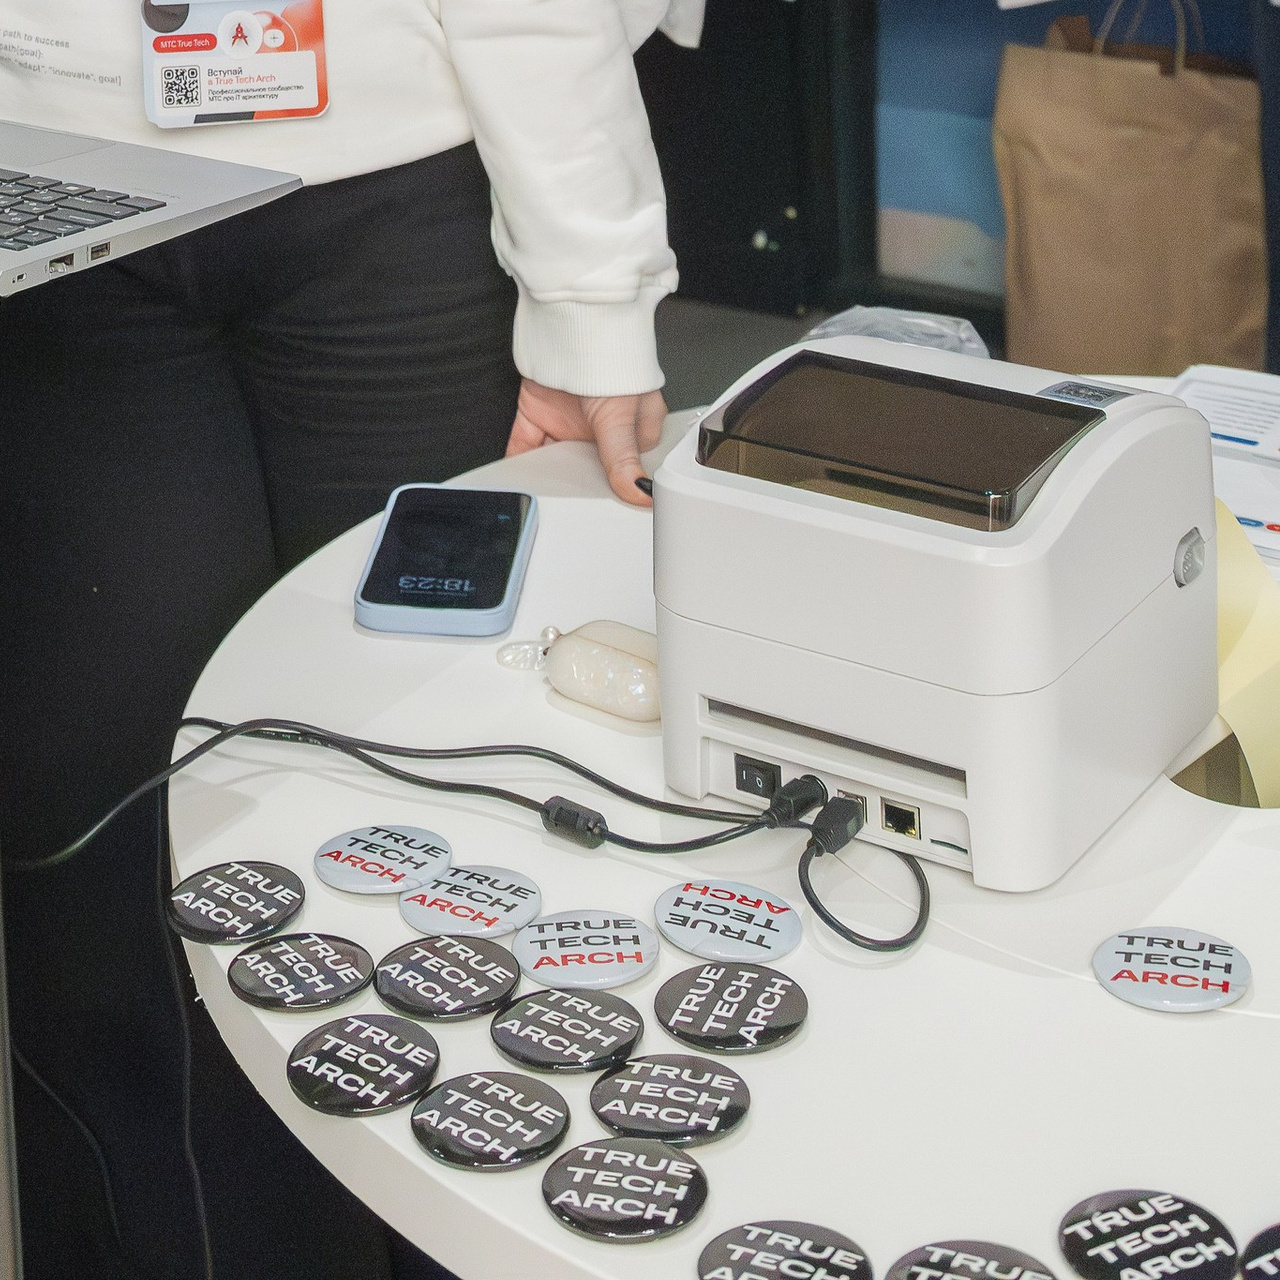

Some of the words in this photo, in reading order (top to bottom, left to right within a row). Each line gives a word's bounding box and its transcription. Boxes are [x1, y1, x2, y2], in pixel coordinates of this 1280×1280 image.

[2, 28, 21, 39] path
[24, 32, 33, 42] to
[35, 35, 70, 49] success
[178, 39, 193, 48] True
[193, 38, 210, 47] Tech
[207, 67, 243, 78] Вступай
[208, 87, 267, 96] Профессиональное
[267, 84, 304, 92] сообщество
[215, 77, 234, 86] True
[235, 76, 255, 85] Tech
[256, 74, 276, 83] Arch
[241, 93, 279, 101] архитектуру
[398, 575, 477, 592] 18:23
[346, 836, 428, 871] TECH
[370, 826, 449, 860] TRUE
[222, 861, 301, 907] TRUE
[319, 849, 407, 884] ARCH
[449, 866, 537, 900] TRUE
[171, 890, 256, 937] ARCH
[203, 874, 278, 920] TECH
[404, 893, 499, 929] ARCH
[430, 879, 519, 914] TECH
[672, 896, 781, 932] TECH
[682, 882, 791, 914] ARCH
[528, 918, 637, 933] TRUE
[529, 934, 640, 951] TECH
[664, 913, 773, 950] TRUE
[299, 933, 365, 985] TRUE
[433, 936, 515, 985] TRUE
[532, 951, 644, 970] ARCH
[1114, 951, 1233, 975] TECH
[1117, 934, 1234, 957] TRUE
[237, 952, 304, 1006] ARCH
[269, 941, 336, 996] TECH
[377, 961, 466, 1013] ARCH
[407, 946, 491, 998] TECH
[1110, 969, 1230, 994] ARCH
[546, 989, 640, 1034] TRUE
[670, 964, 726, 1029] TRUE
[703, 970, 760, 1033] TECH
[739, 977, 792, 1044] ARCH
[342, 1017, 438, 1065] TRUE
[494, 1017, 598, 1065] ARCH
[524, 1002, 619, 1049] TECH
[320, 1035, 414, 1086] TECH
[625, 1061, 740, 1091] TRUE
[291, 1054, 393, 1107] ARCH
[616, 1080, 730, 1111] TECH
[443, 1089, 542, 1143] TECH
[468, 1073, 565, 1126] TRUE
[598, 1099, 721, 1132] ARCH
[412, 1107, 517, 1163] ARCH
[577, 1146, 697, 1179] TRUE
[564, 1166, 688, 1202] TECH
[551, 1187, 679, 1226] ARCH
[1063, 1194, 1184, 1241] TRUE
[743, 1225, 865, 1270] TRUE
[1086, 1214, 1210, 1264] TECH
[1120, 1237, 1236, 1280] ARCH
